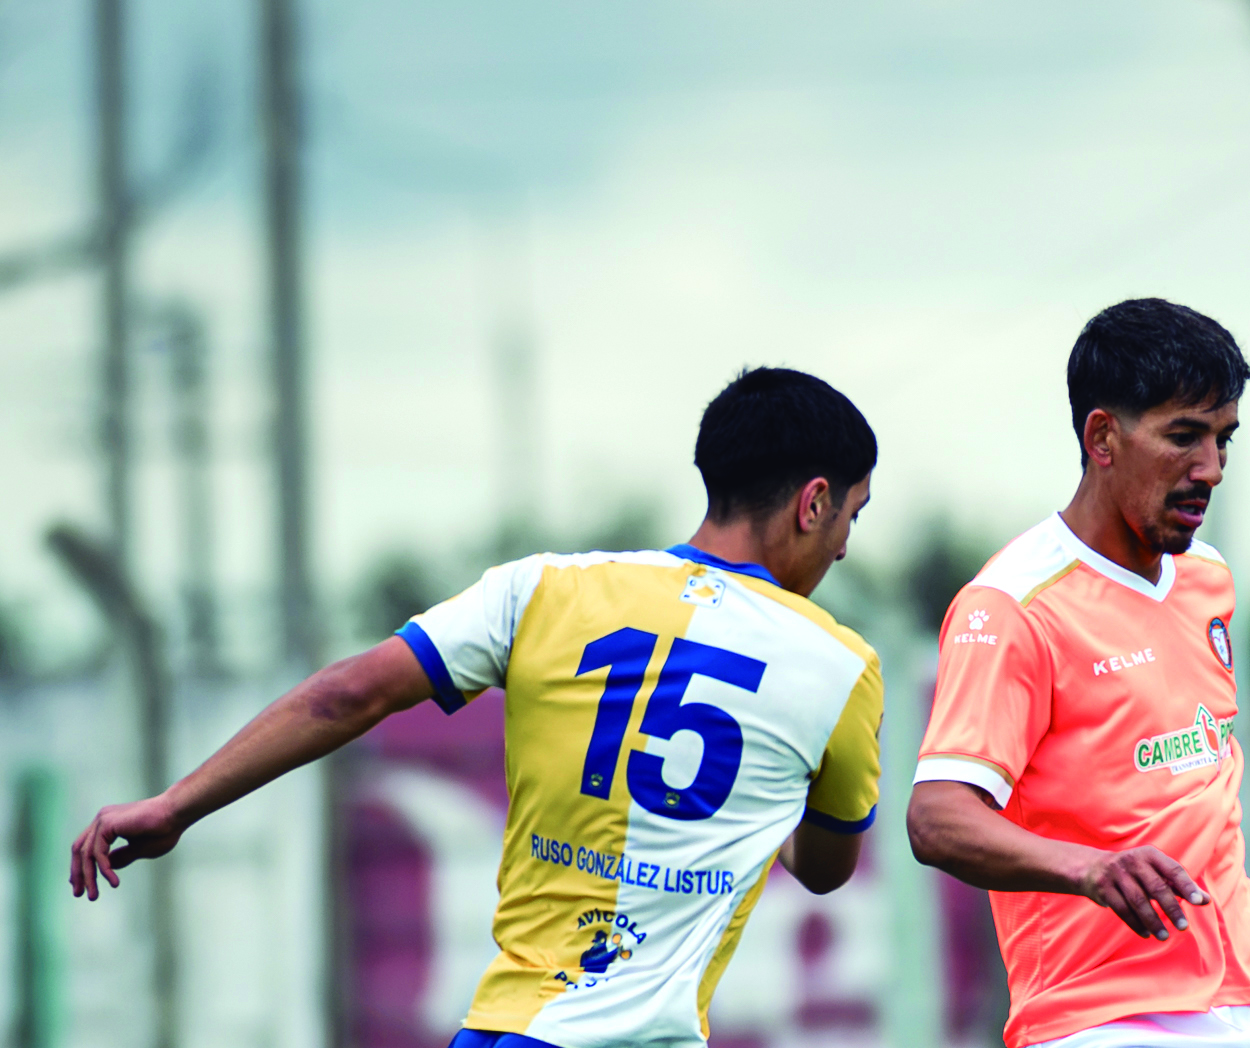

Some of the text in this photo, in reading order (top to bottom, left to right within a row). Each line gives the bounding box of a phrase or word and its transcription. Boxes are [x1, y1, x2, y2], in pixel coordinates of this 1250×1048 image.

[954, 633, 998, 645] KELME
[1093, 648, 1156, 676] KELME
[575, 626, 767, 821] 15
[1137, 730, 1204, 767] CAMBRE
[531, 833, 573, 867] RUSO
[663, 867, 734, 894] LISTUR
